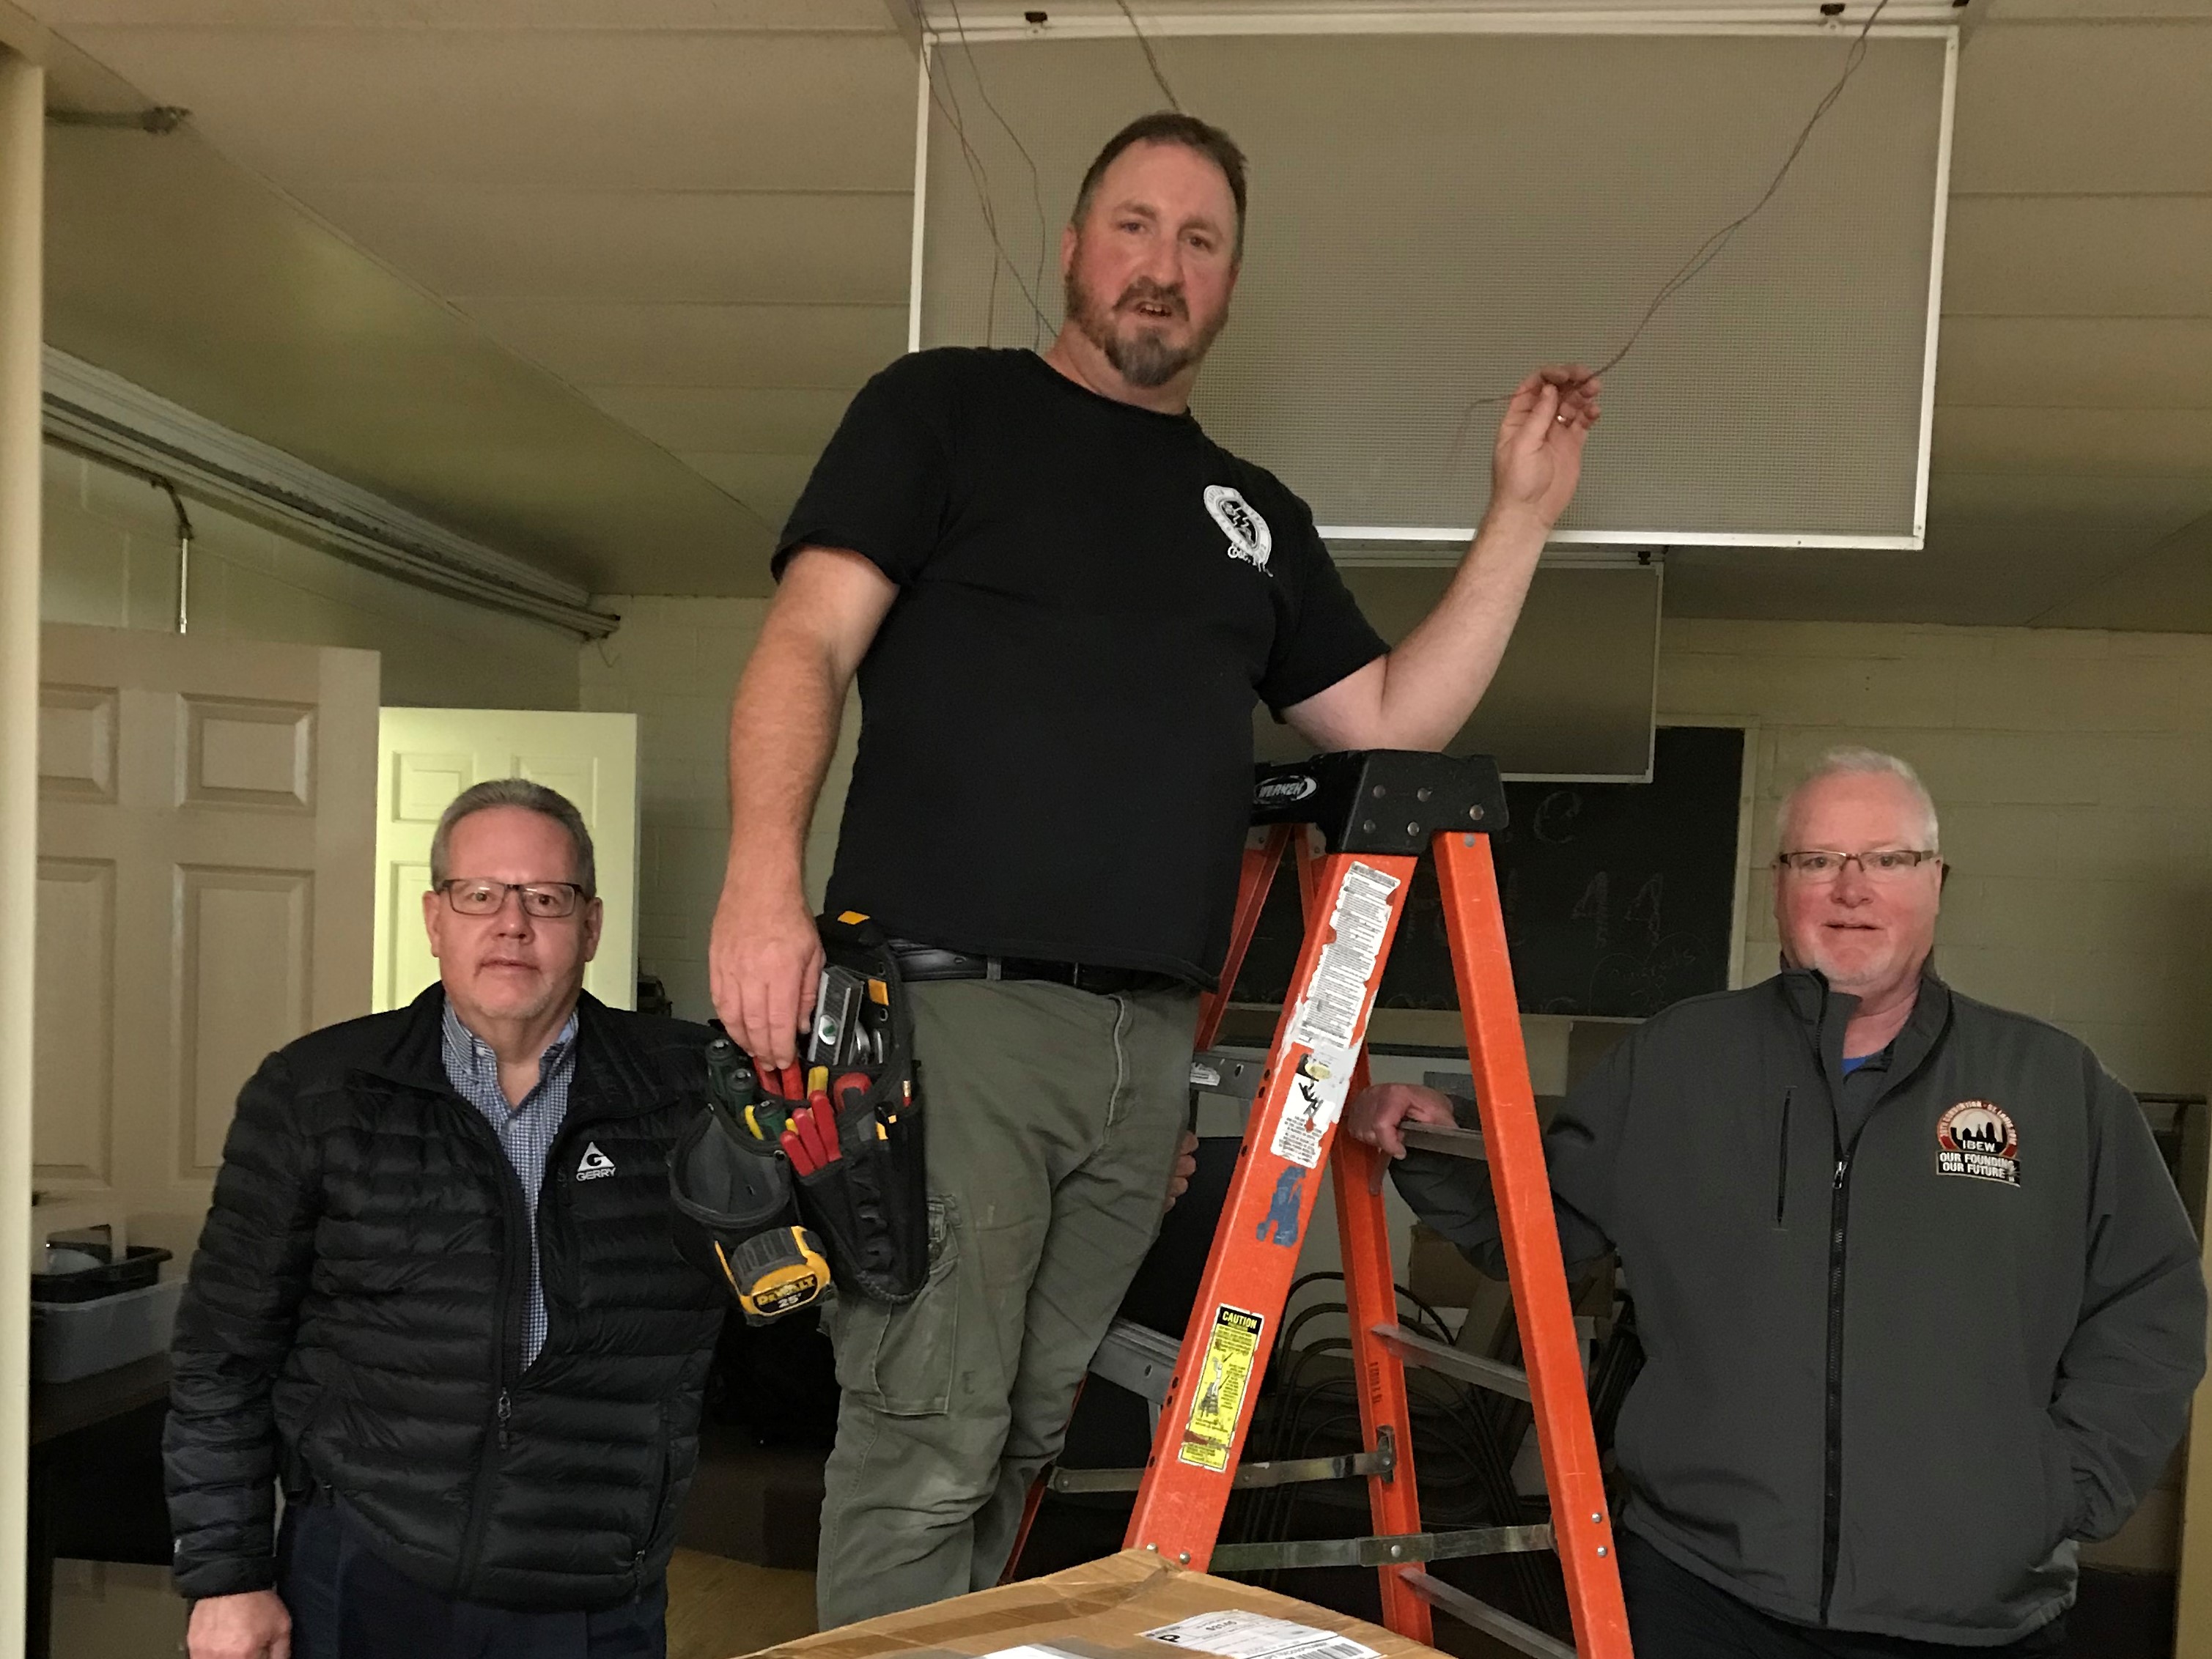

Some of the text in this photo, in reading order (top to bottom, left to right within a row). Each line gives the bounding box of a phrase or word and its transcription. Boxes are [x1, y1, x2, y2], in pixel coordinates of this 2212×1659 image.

[1962, 1139, 1995, 1153] IBEW
[1939, 1152, 1961, 1162] OUR
[576, 1167, 616, 1181] GERRY
[1942, 1161, 2006, 1179] OUR FUTURE
[1222, 1310, 1258, 1330] CAUTION
